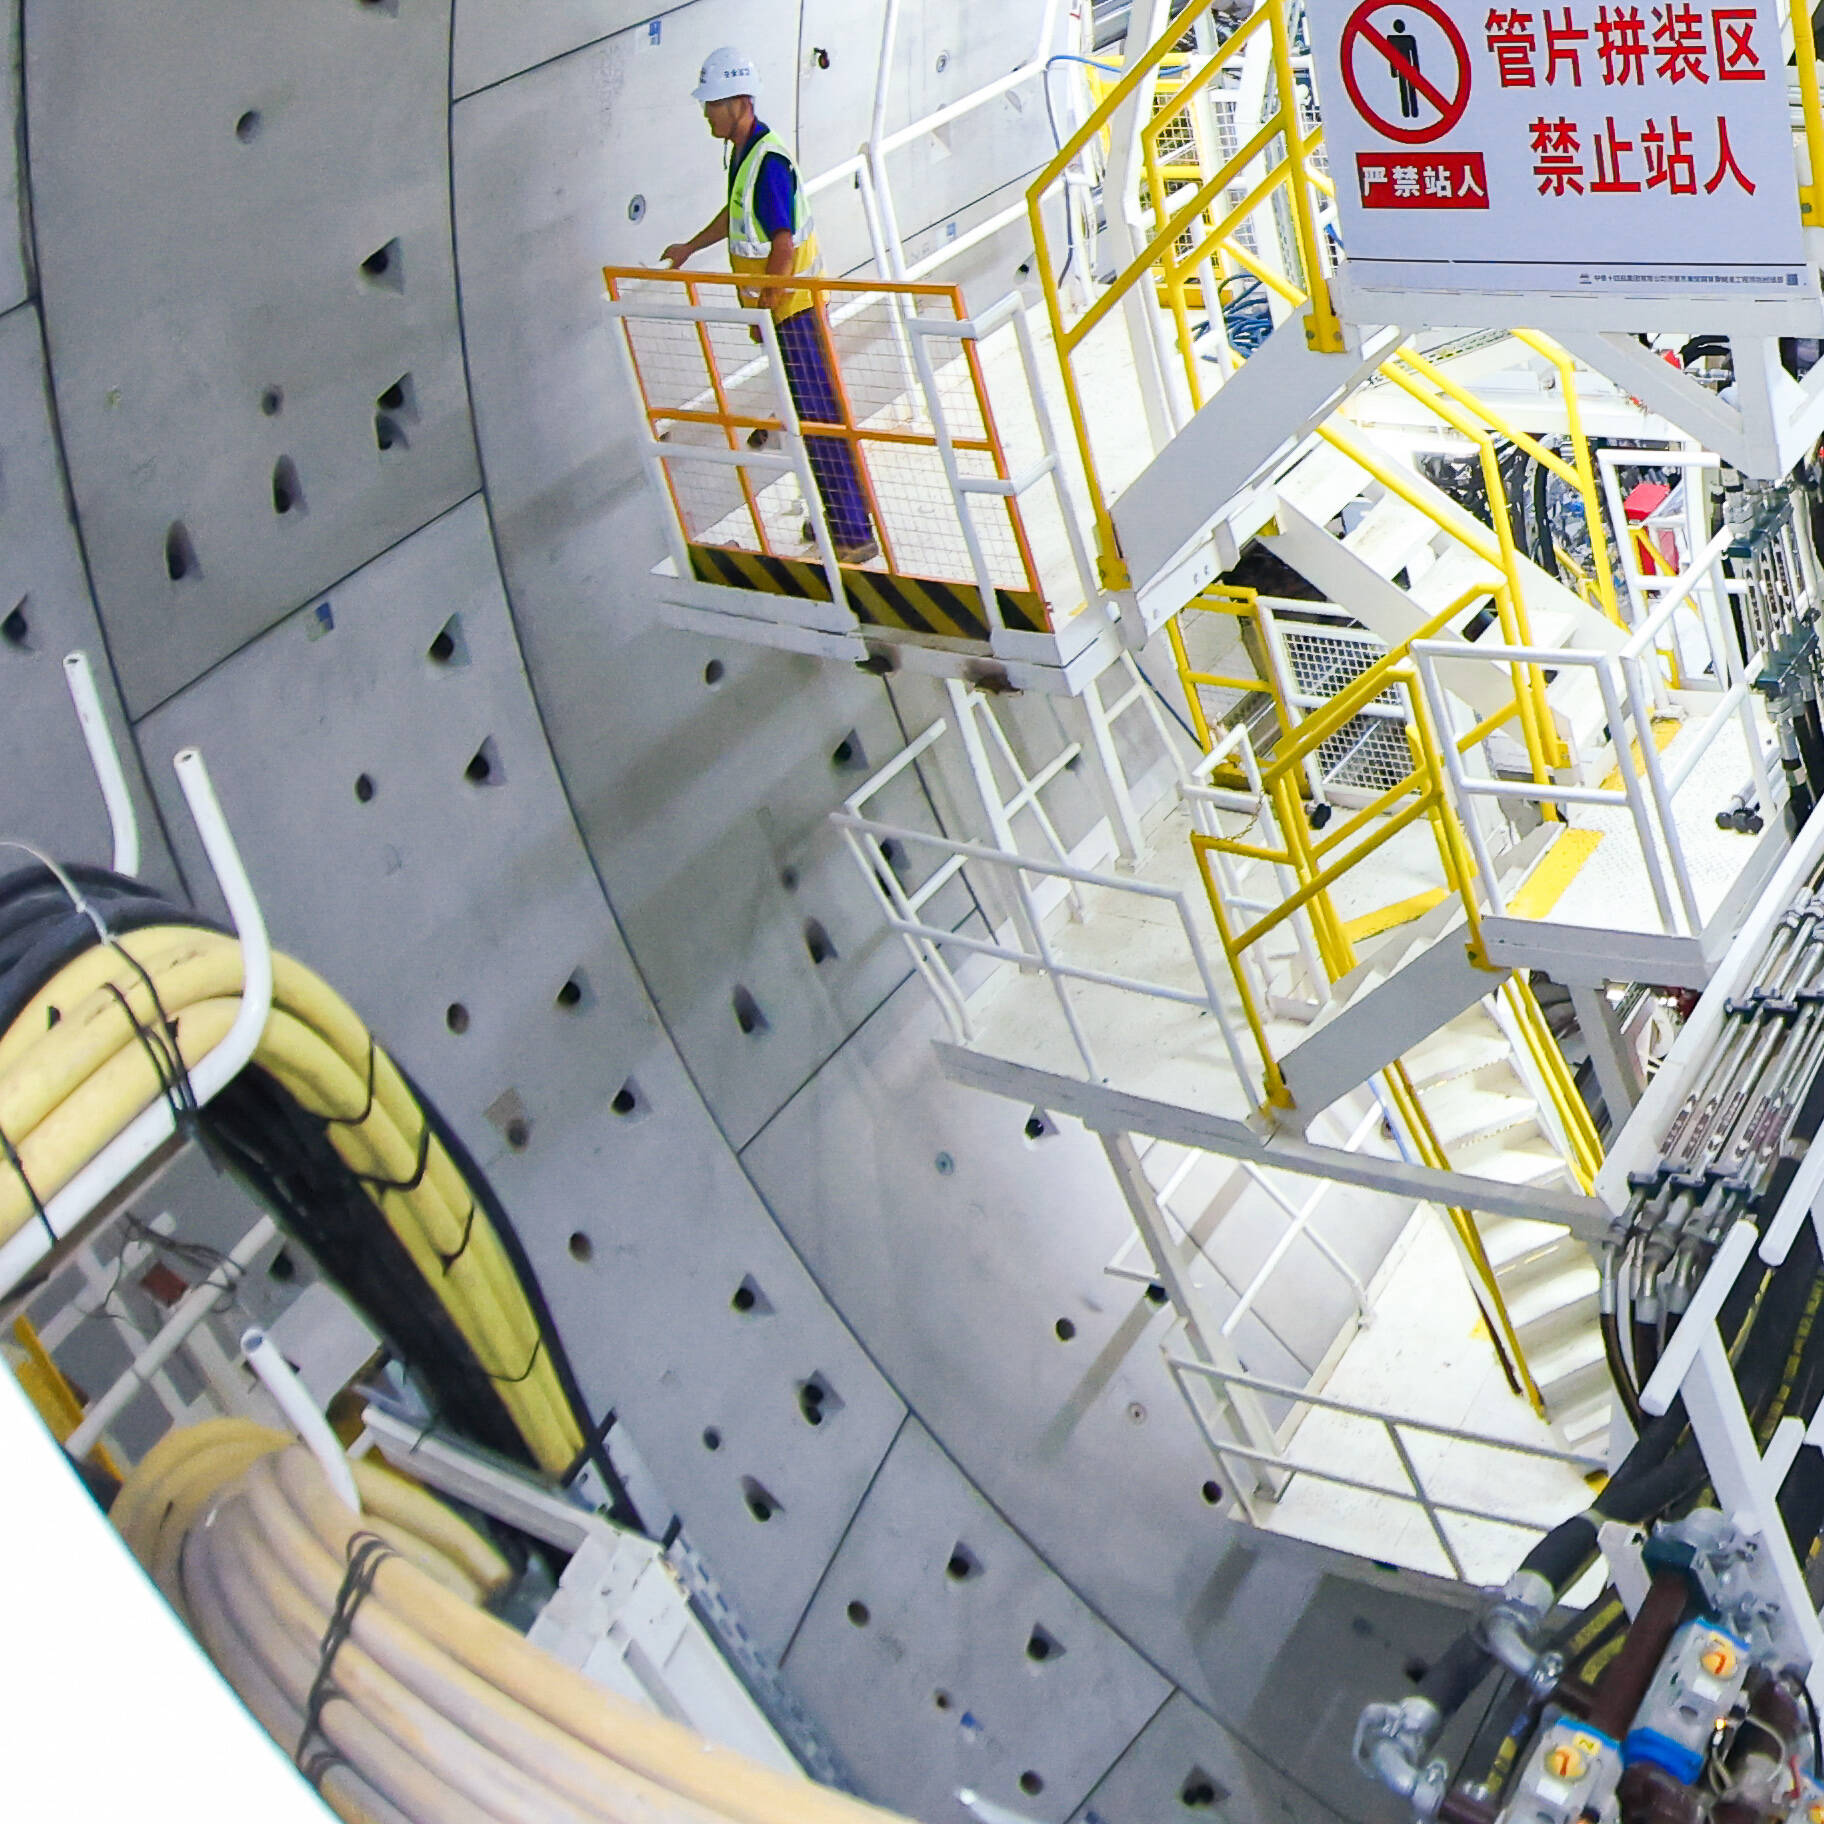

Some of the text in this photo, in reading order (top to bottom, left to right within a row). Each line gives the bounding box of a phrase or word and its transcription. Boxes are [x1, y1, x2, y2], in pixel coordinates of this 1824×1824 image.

[1485, 3, 1767, 88] 管片拼装区
[1362, 164, 1487, 198] 严禁站人
[1528, 115, 1757, 196] 禁止站人
